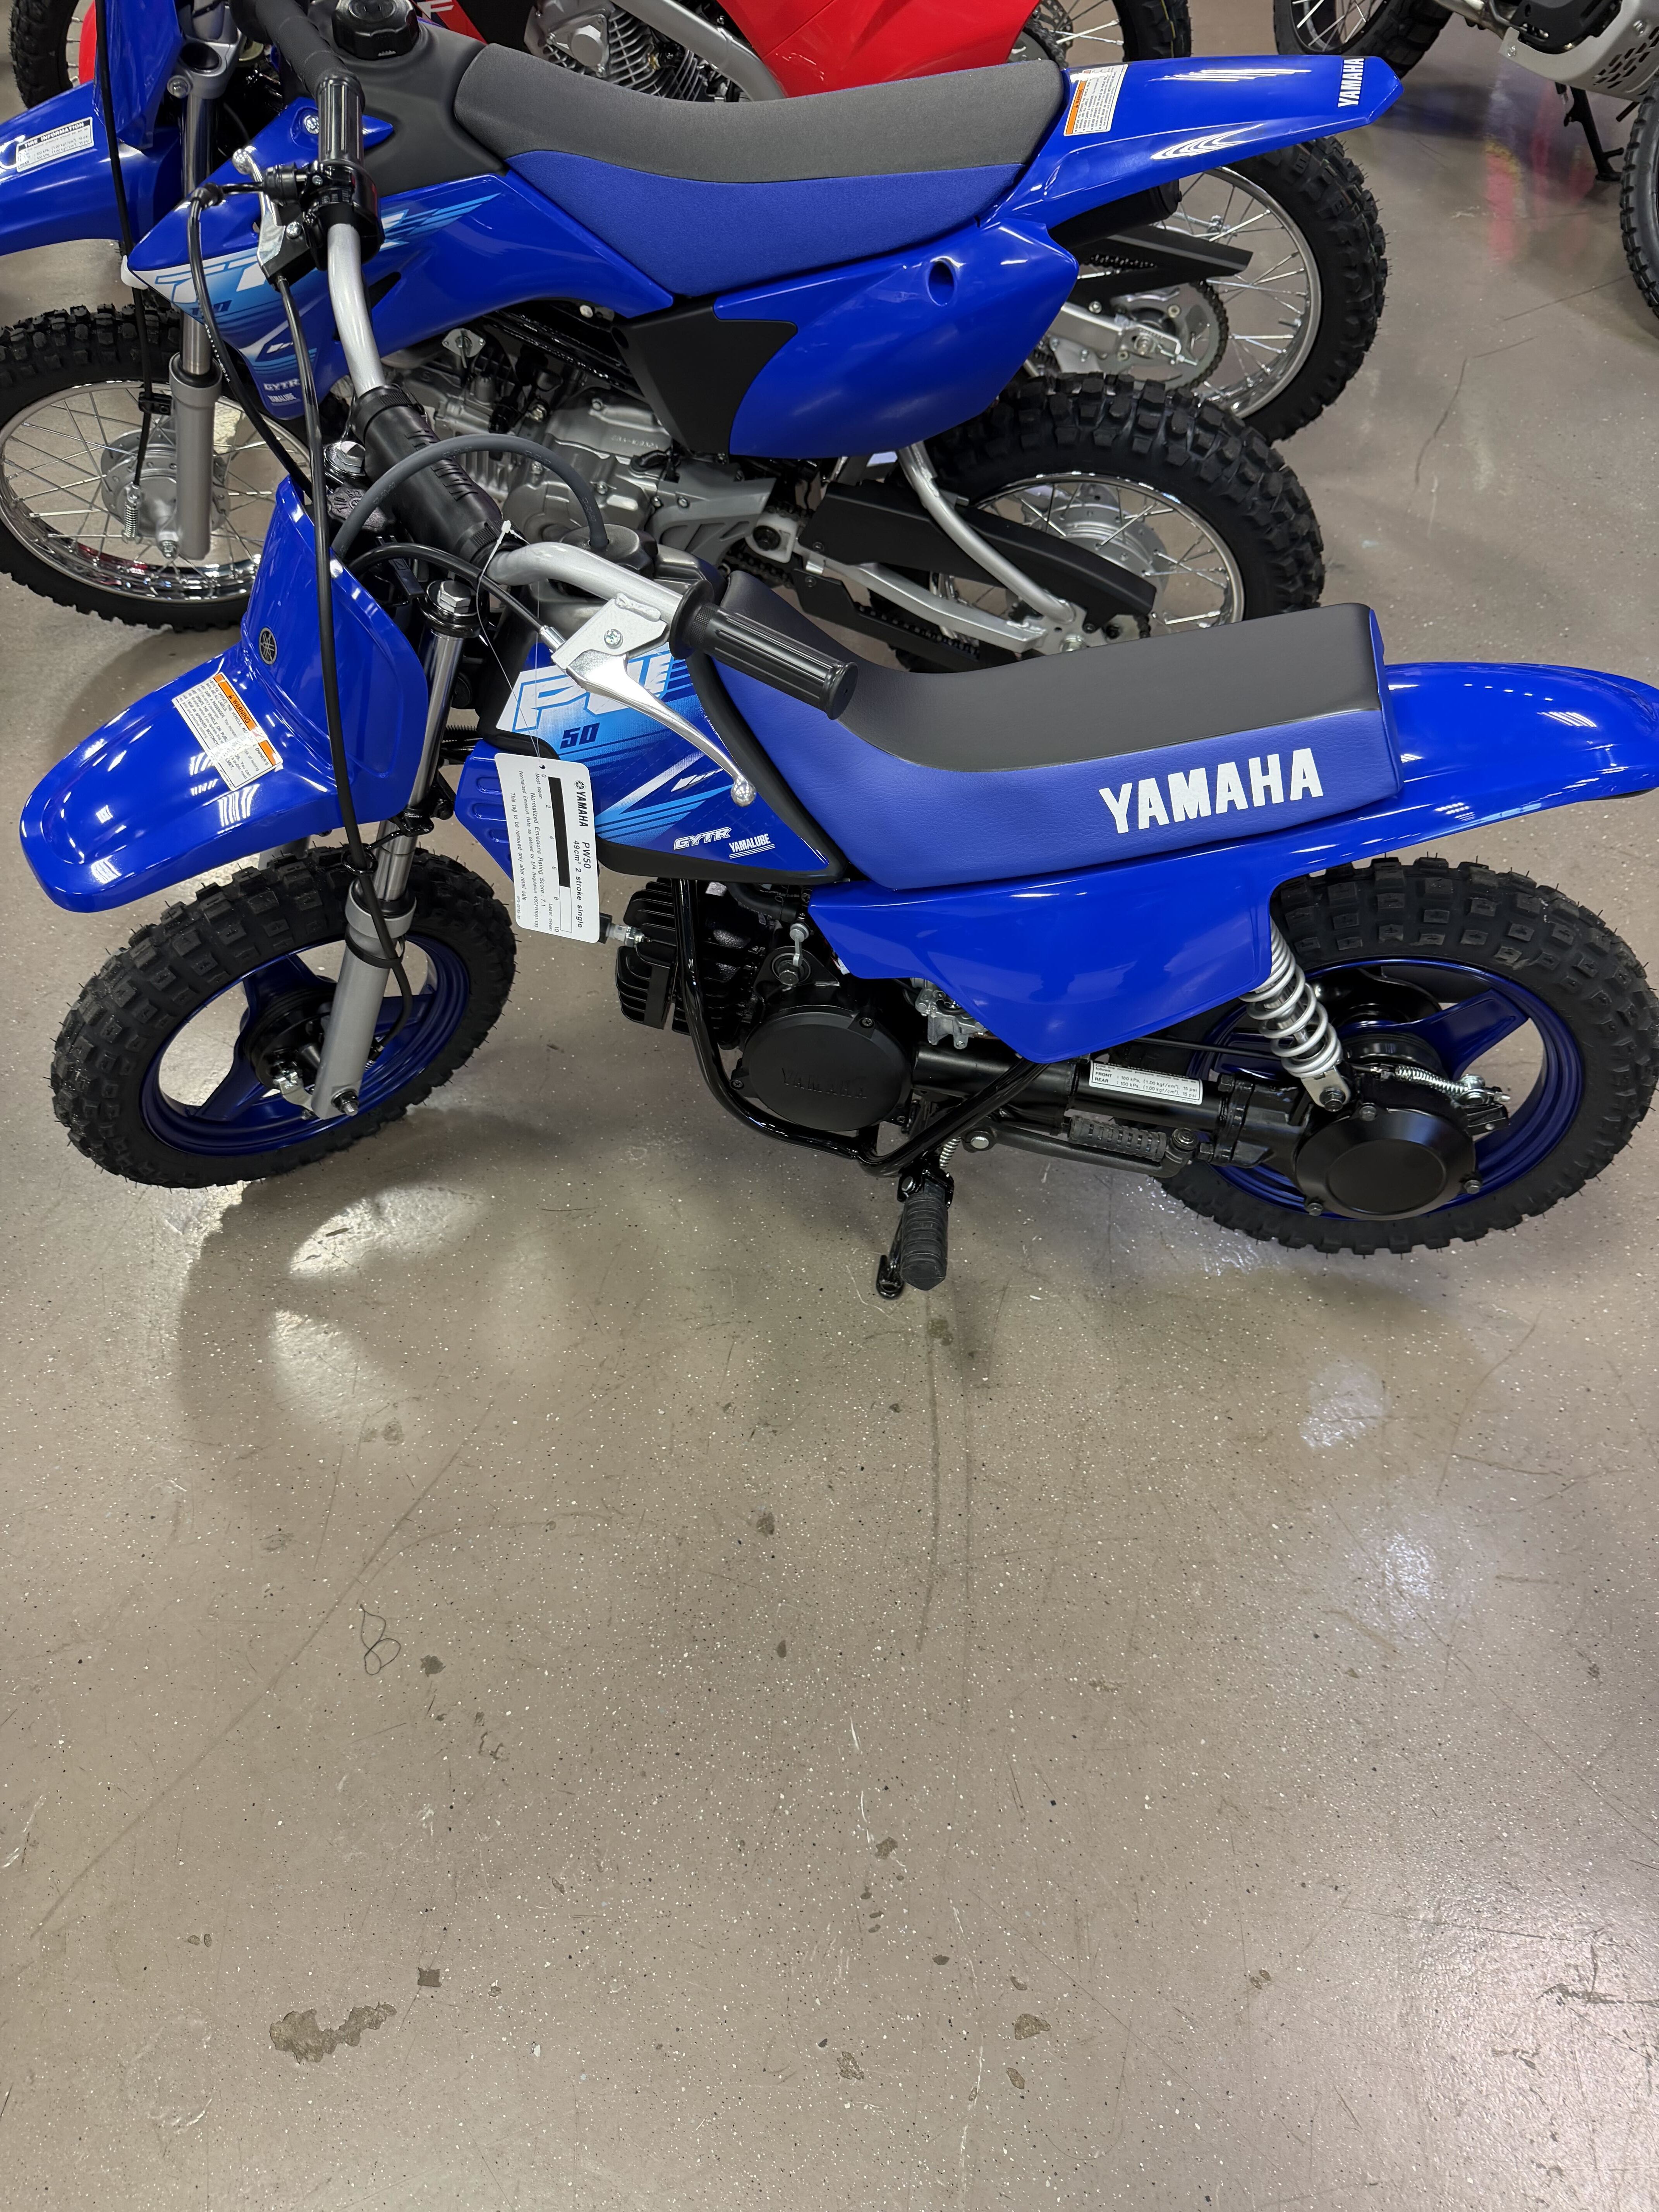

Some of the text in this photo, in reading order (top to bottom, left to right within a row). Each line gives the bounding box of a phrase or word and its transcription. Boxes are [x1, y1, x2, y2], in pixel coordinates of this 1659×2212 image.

[1338, 58, 1364, 108] YAMAHA
[41, 122, 84, 141] INFORMATION
[263, 378, 301, 391] GYTR
[194, 712, 208, 729] APPROVED
[231, 699, 252, 724] WARNING
[206, 712, 218, 726] VEHICLE
[239, 761, 247, 769] You
[230, 711, 244, 727] VEHICLE
[254, 747, 270, 766] OWNER'S
[560, 722, 600, 749] 50
[208, 723, 218, 735] operate
[232, 759, 242, 771] public
[240, 770, 248, 780] road
[249, 759, 260, 772] losing
[1099, 748, 1323, 834] YAMAHA
[529, 792, 539, 824] Normalized
[518, 771, 527, 794] Normalized
[531, 871, 539, 894] Regulation
[534, 826, 543, 854] Emissions
[576, 790, 591, 869] YAMAHA PW50
[673, 826, 732, 850] GYTR
[729, 834, 771, 853] YAMALUBE
[536, 856, 544, 875] Rating
[575, 876, 583, 901] stroke
[574, 904, 585, 929] single
